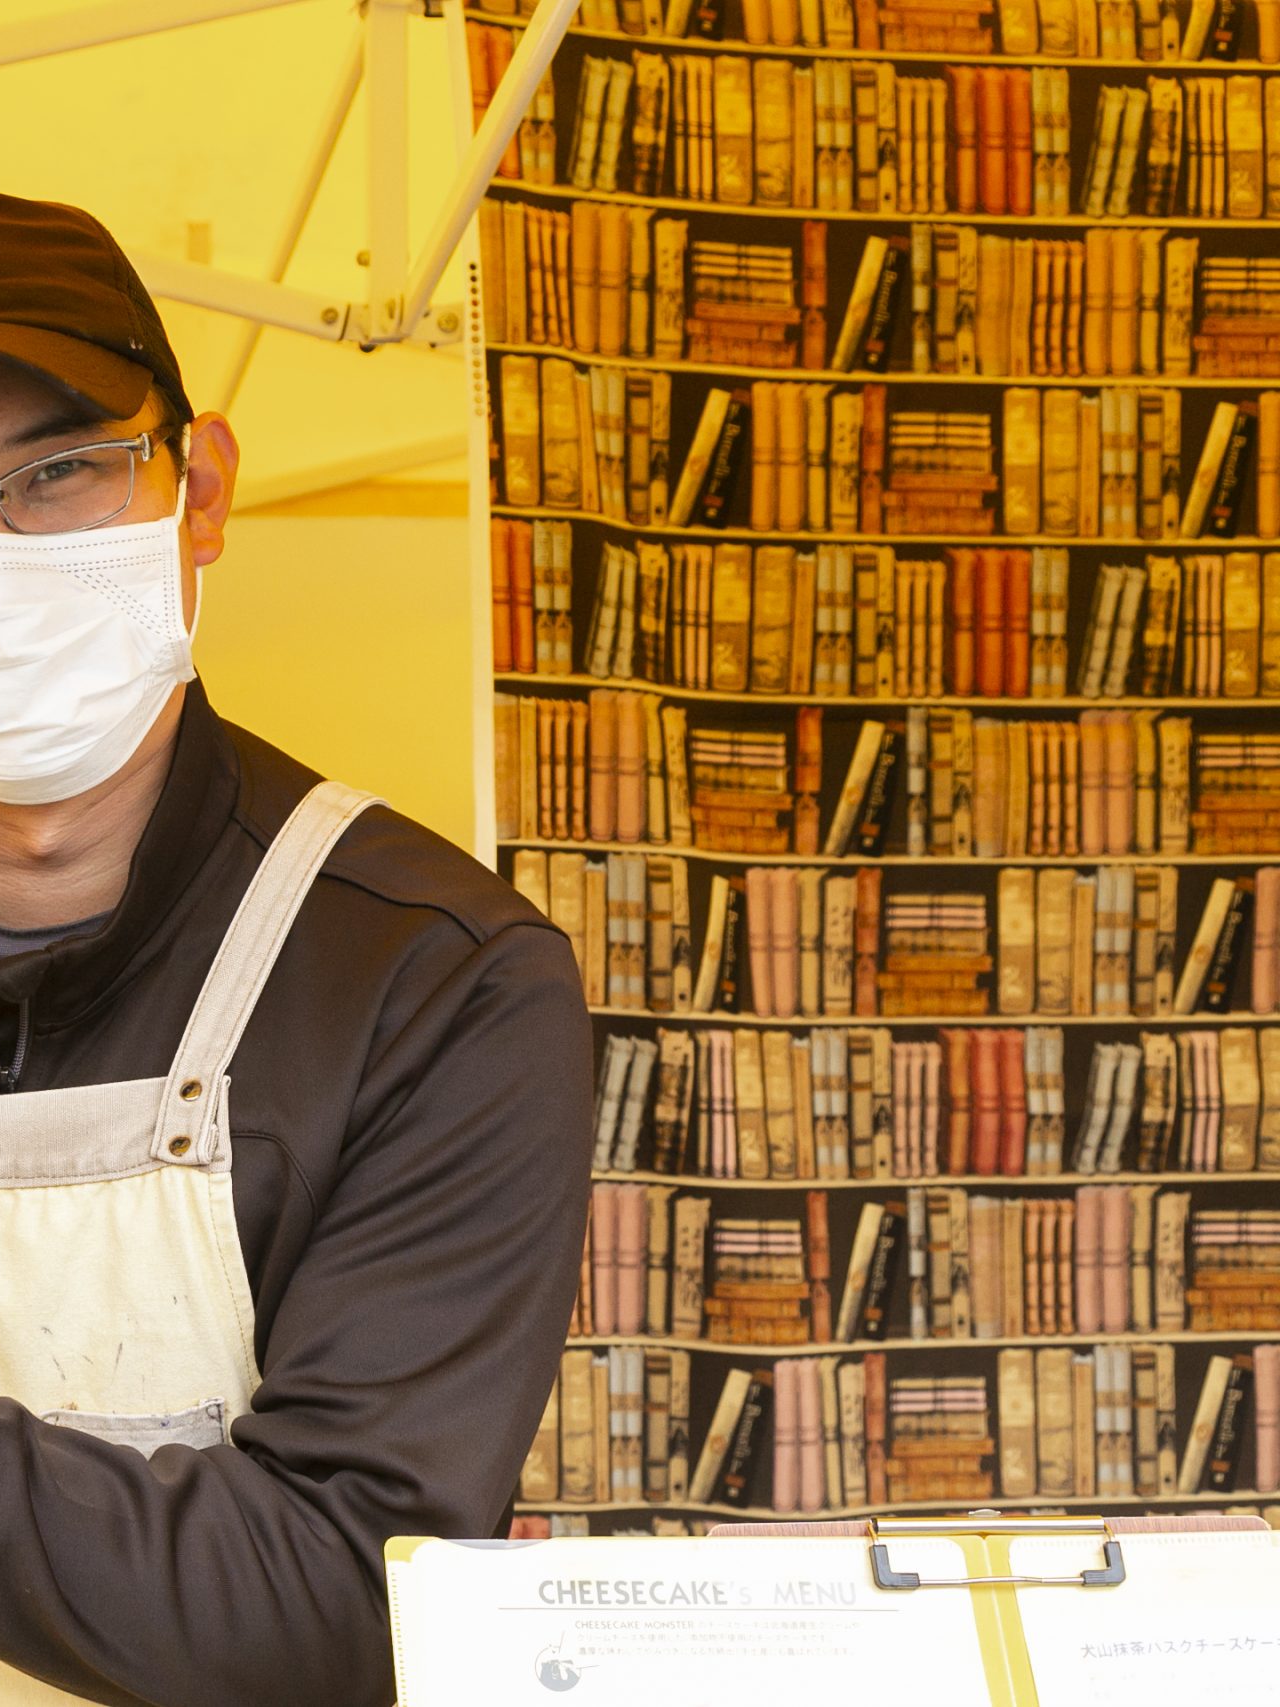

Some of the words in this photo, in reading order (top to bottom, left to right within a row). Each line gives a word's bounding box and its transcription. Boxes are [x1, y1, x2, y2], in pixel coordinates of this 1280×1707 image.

[538, 1579, 753, 1605] CHEESECAKE's
[773, 1581, 857, 1605] MENU
[574, 1620, 640, 1630] CHEESECAKE
[644, 1620, 694, 1630] MONSTER
